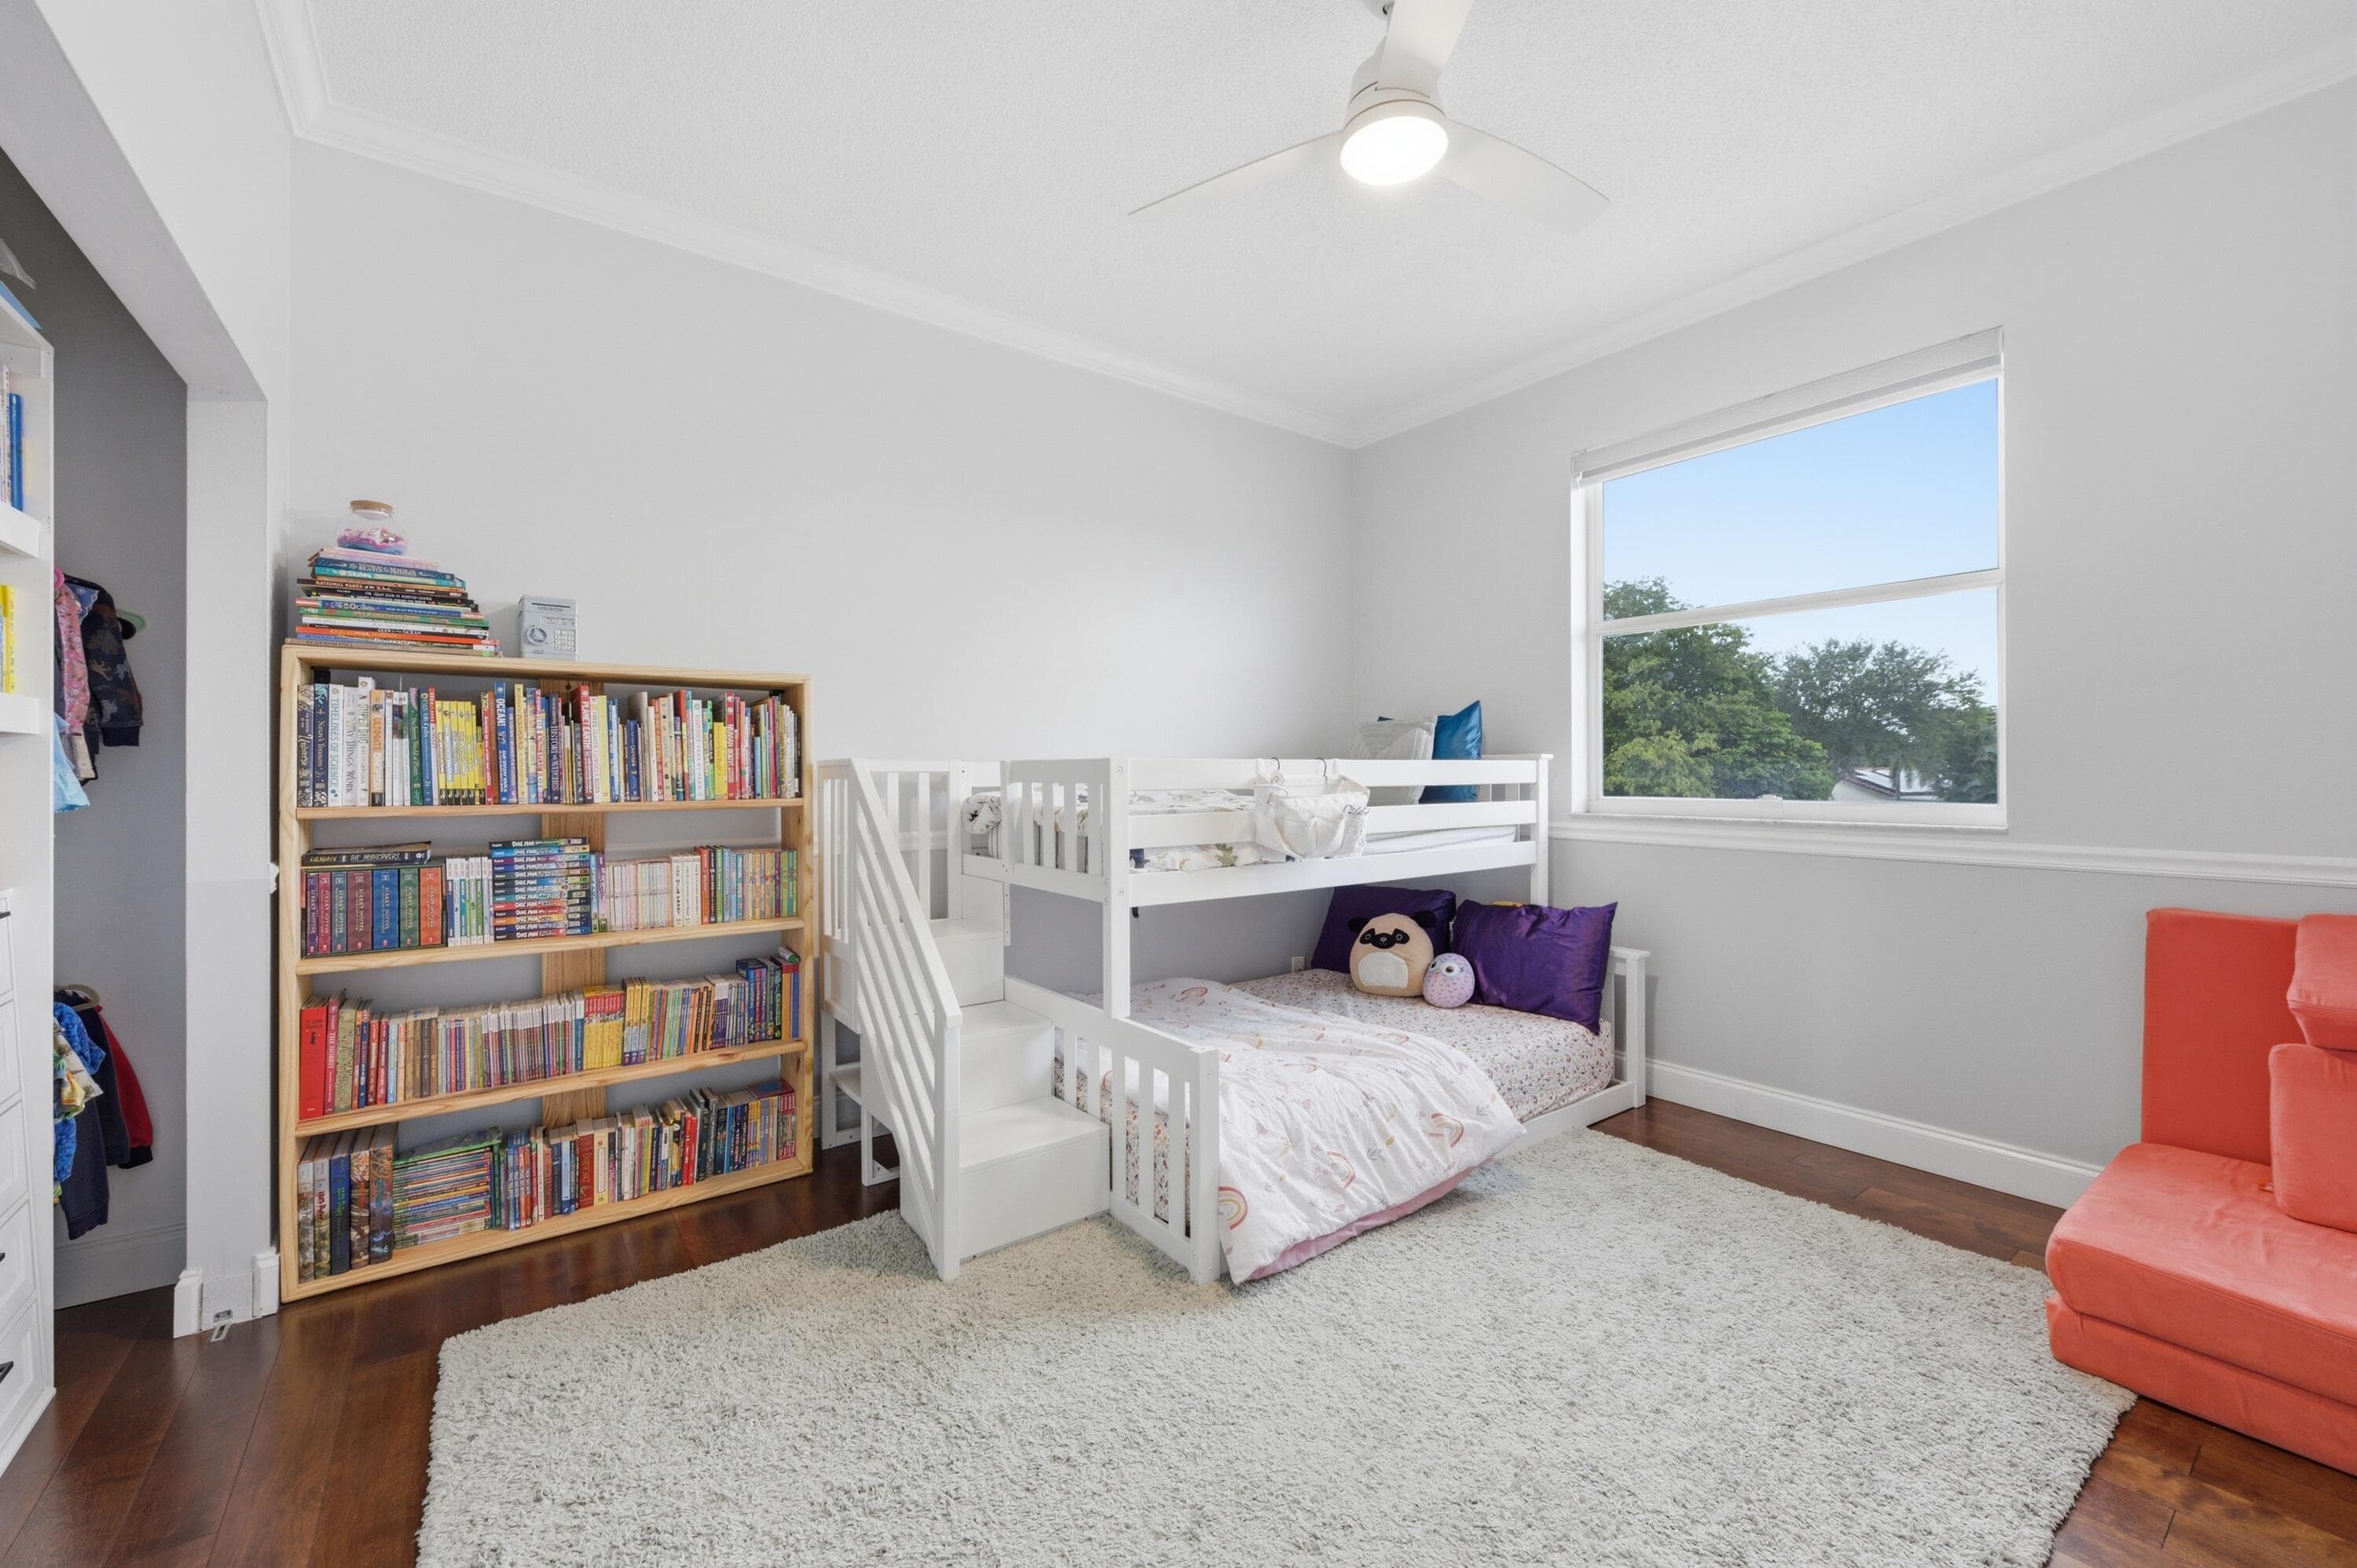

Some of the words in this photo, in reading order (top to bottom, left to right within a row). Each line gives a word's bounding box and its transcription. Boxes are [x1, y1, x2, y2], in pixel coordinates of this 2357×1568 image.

[331, 698, 339, 741] TIMELINES
[497, 698, 506, 727] OCEAN!
[373, 717, 382, 750] ULTIMATE
[331, 743, 339, 753] OF
[346, 741, 356, 767] THINGS
[346, 770, 356, 793] WORK
